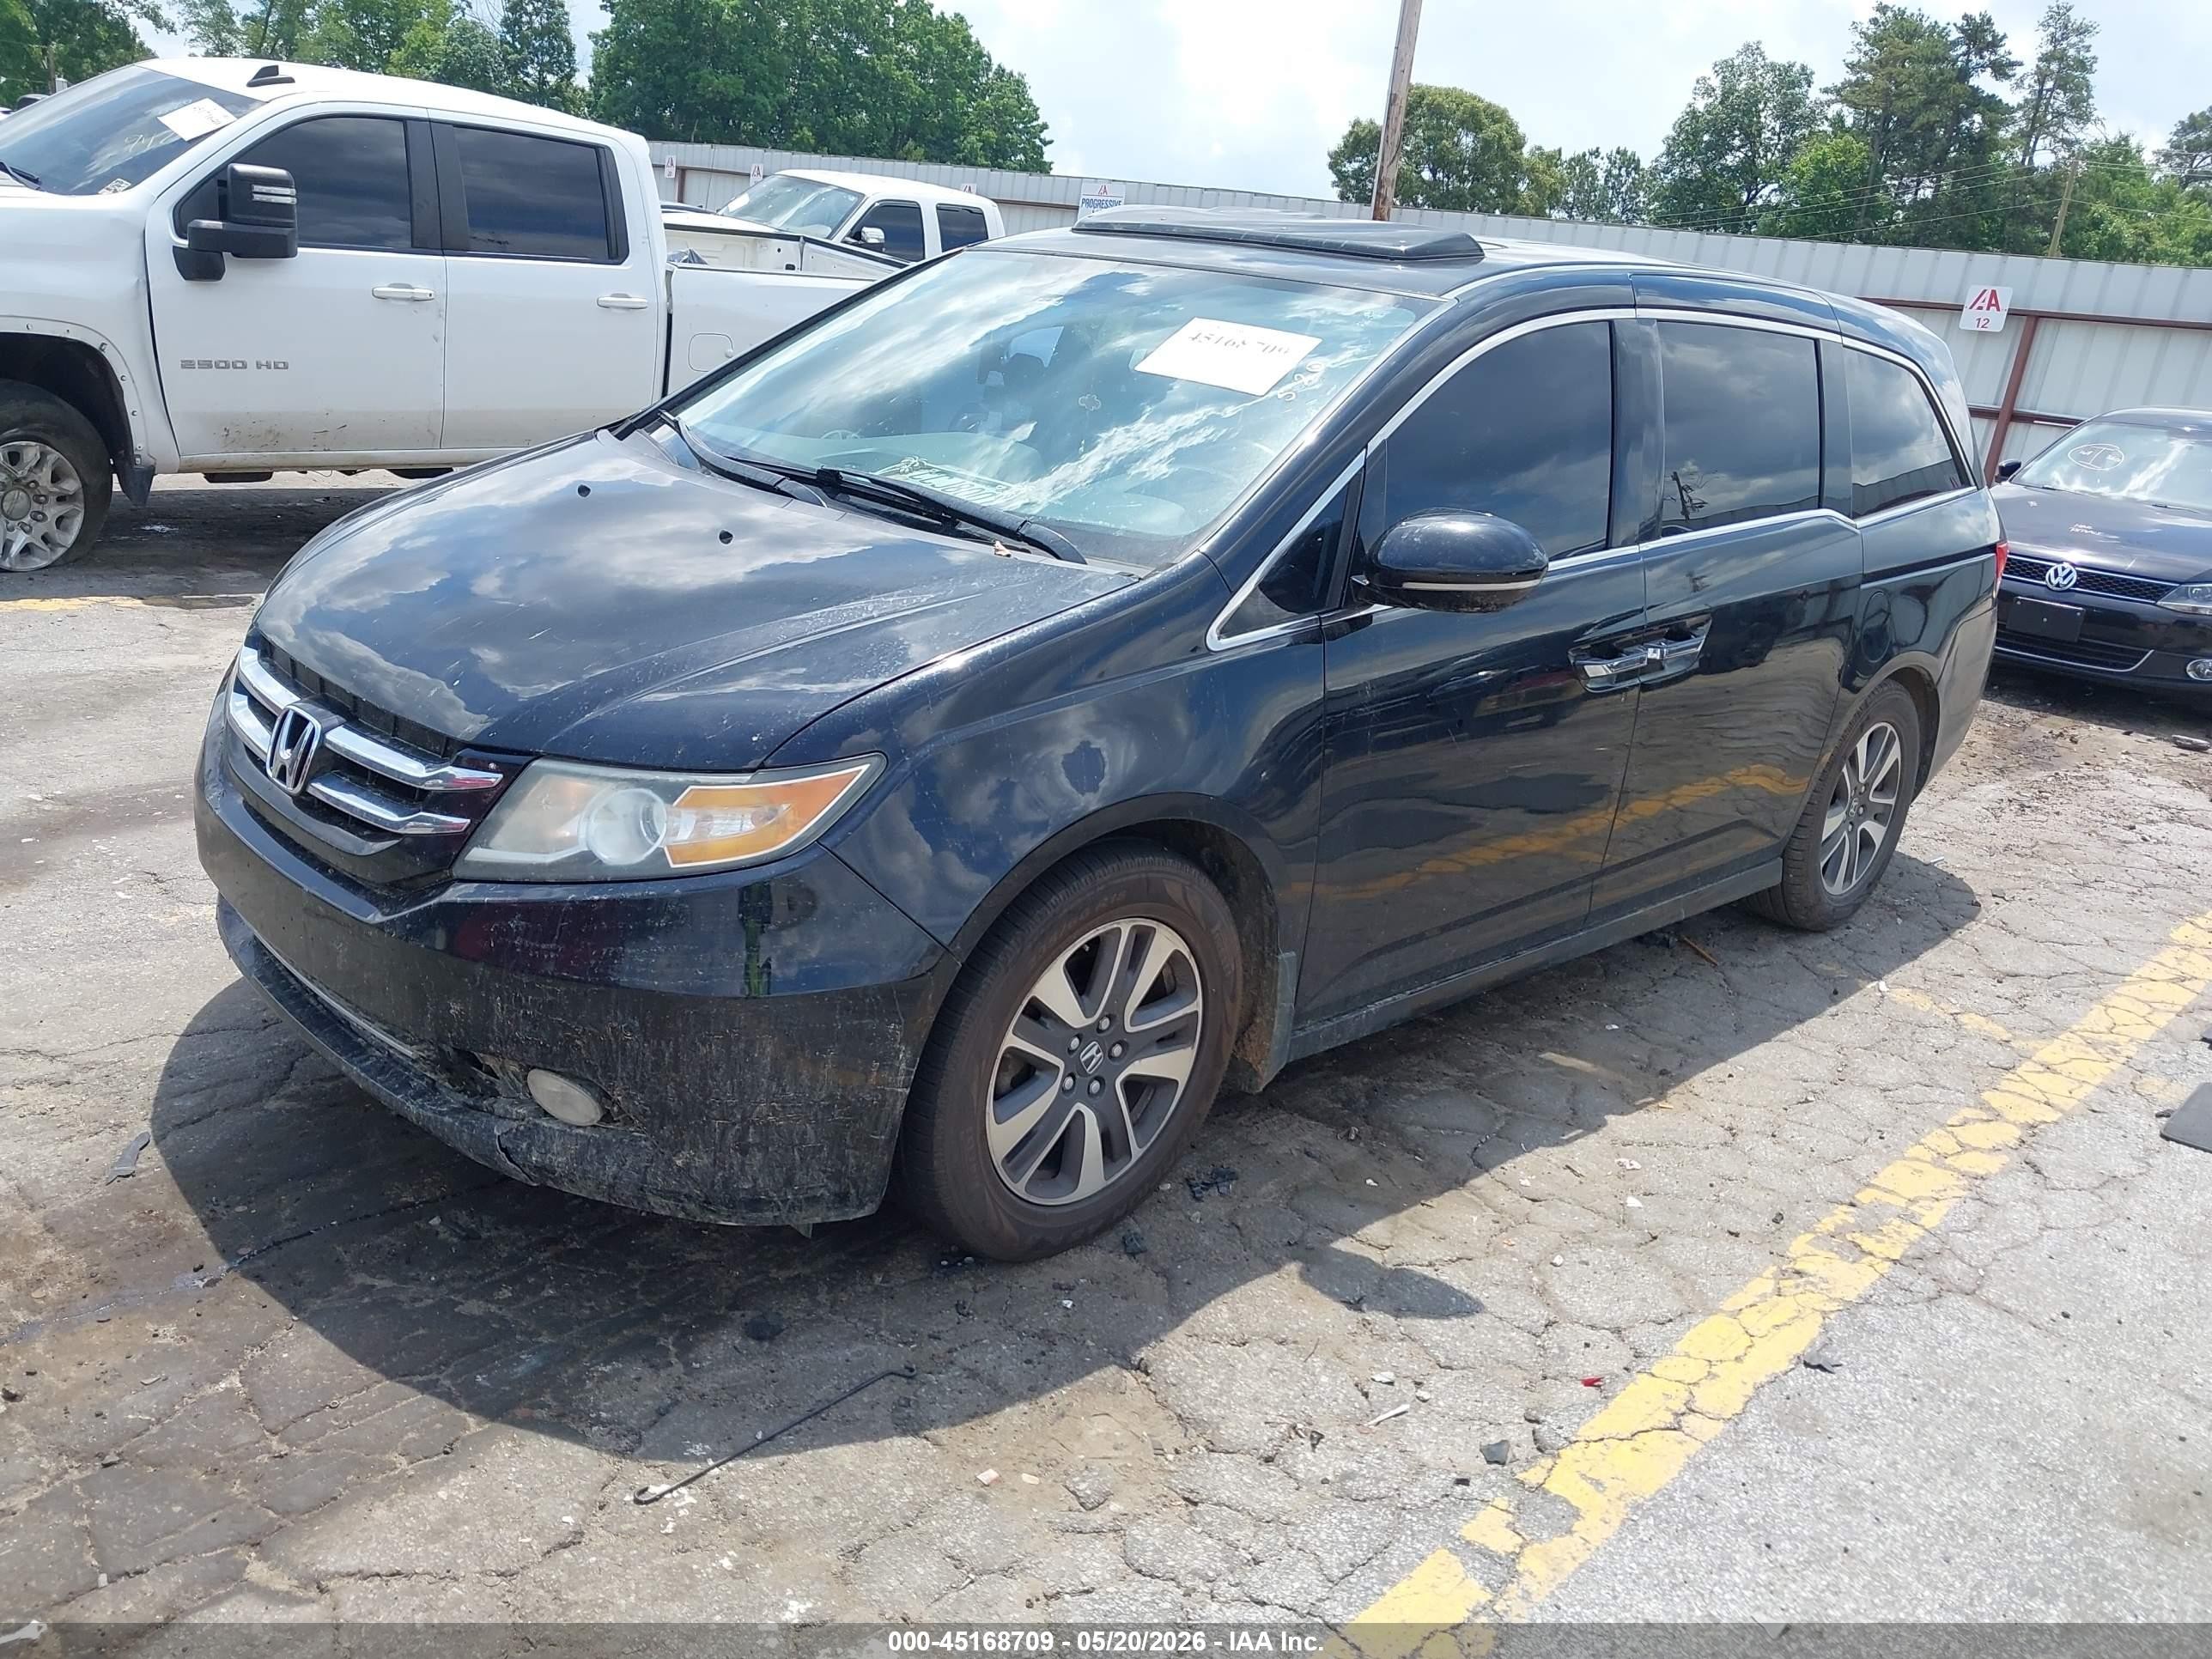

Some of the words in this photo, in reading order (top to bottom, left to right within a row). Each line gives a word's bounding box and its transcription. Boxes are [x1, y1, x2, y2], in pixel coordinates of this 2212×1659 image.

[1081, 198, 1122, 209] PROGRESSIVE
[1975, 317, 1990, 329] 12
[180, 360, 248, 369] 2500
[255, 360, 289, 370] HD
